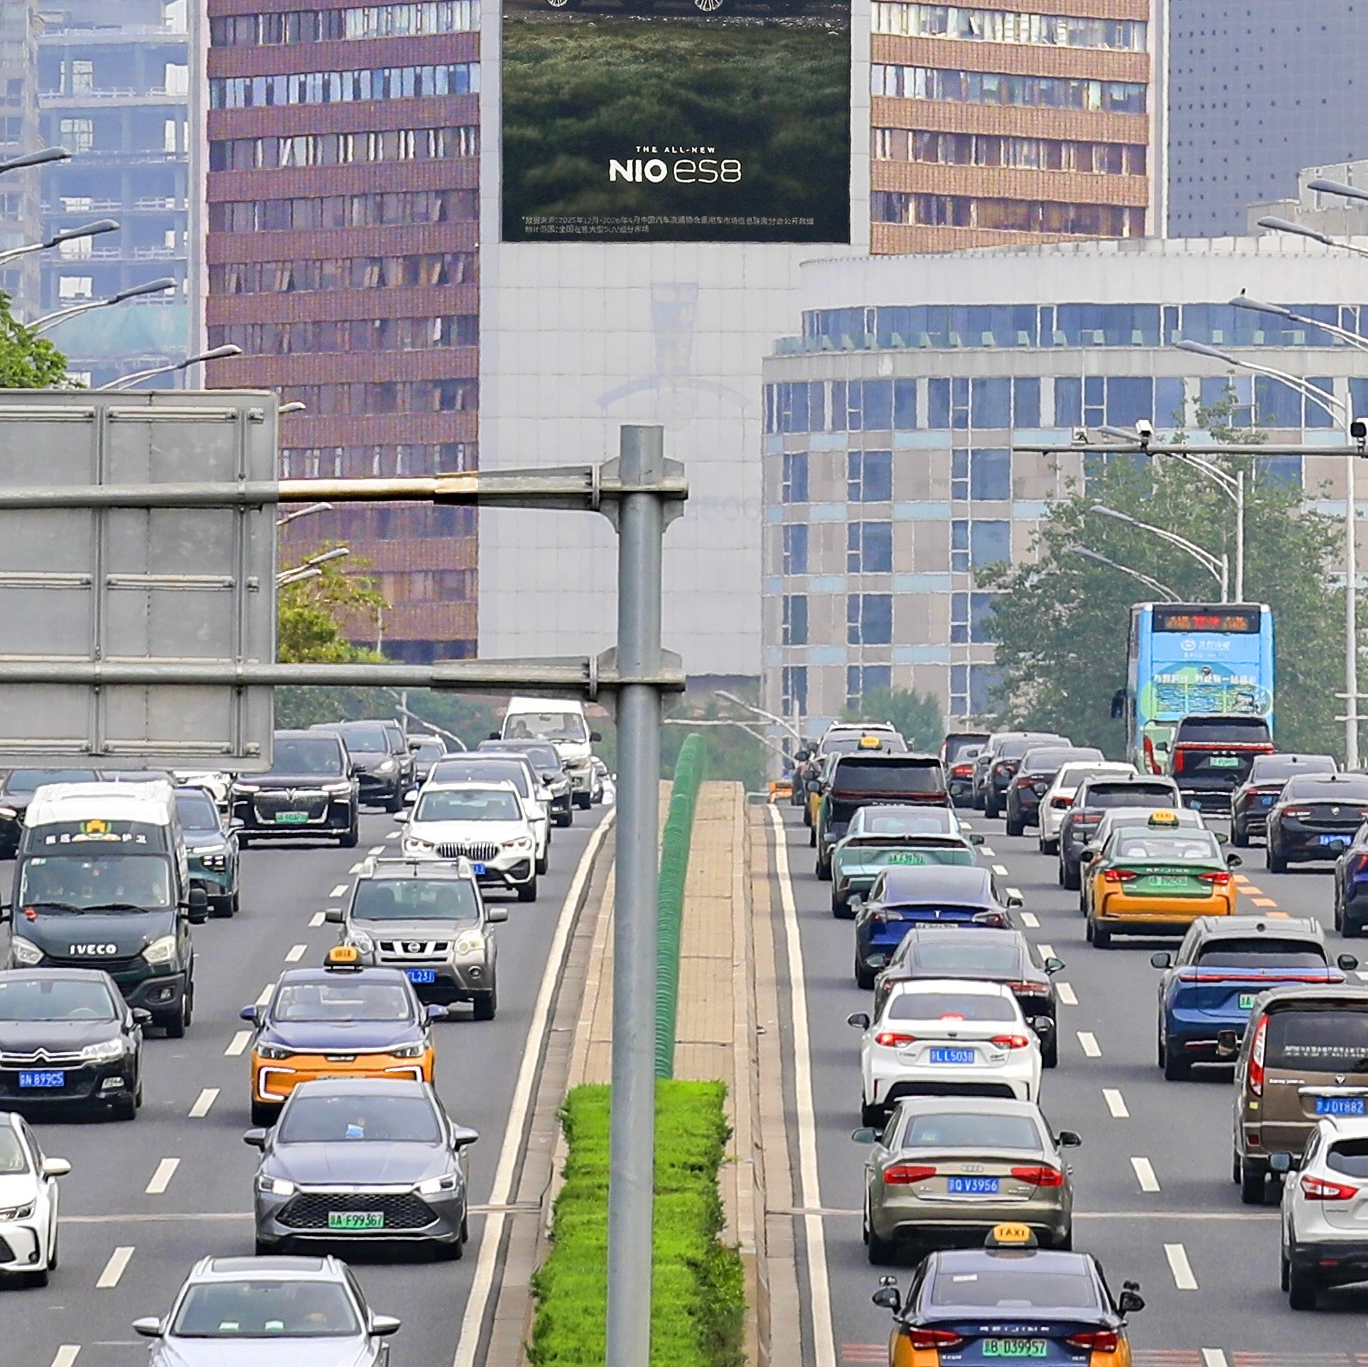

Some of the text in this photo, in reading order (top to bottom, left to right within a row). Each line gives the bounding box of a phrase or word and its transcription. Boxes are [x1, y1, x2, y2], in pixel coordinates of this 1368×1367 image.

[635, 145, 716, 154] THE ALL-NEW
[608, 158, 668, 183] NIO
[70, 944, 117, 955] IVECO
[999, 1229, 1026, 1237] TAXI
